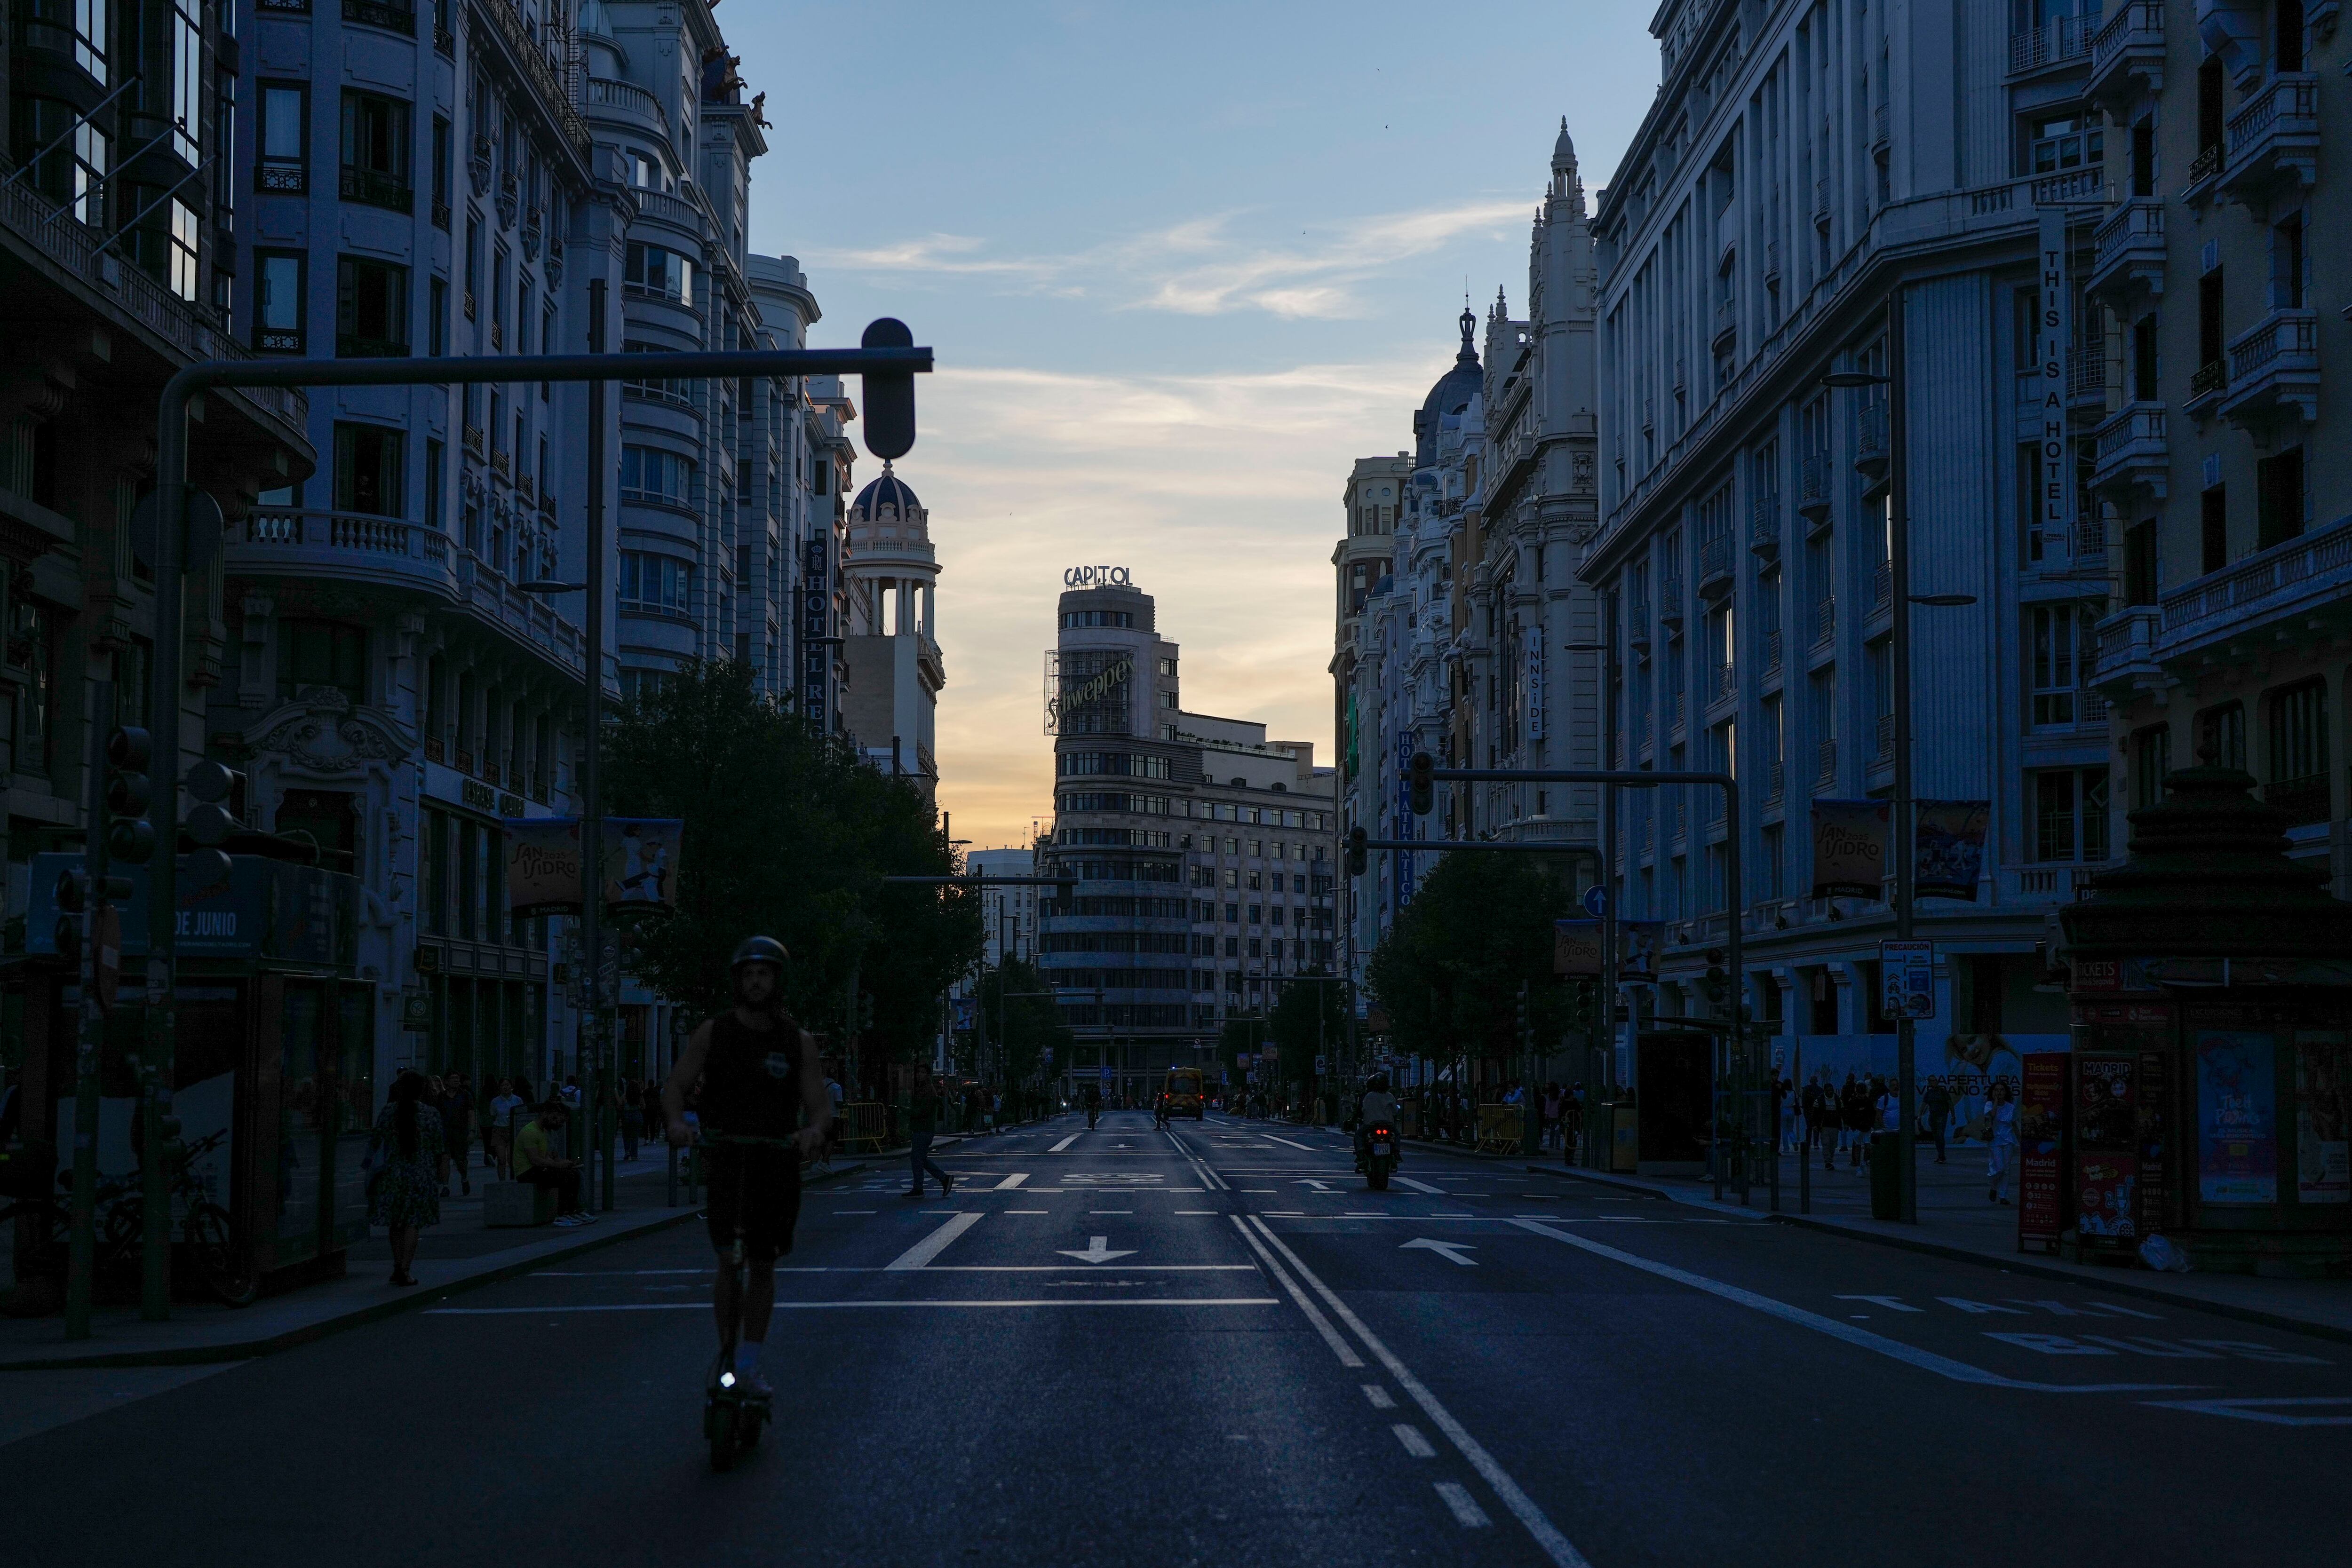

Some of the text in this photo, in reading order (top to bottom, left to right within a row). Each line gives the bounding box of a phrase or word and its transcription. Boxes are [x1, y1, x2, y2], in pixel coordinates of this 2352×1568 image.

[2045, 251, 2059, 327] THIS
[2046, 340, 2059, 379] IS
[2045, 392, 2061, 408] A
[2046, 421, 2061, 520] HOTEL
[1064, 565, 1133, 586] CAPITOL
[807, 576, 826, 673] HOTEL
[1048, 654, 1136, 728] Schweppes
[462, 778, 495, 810] ESPASA
[1400, 734, 1411, 906] HOTL ATLNTICO
[1817, 823, 1846, 844] SAN
[511, 842, 543, 864] SAN
[1834, 886, 1864, 895] MADRID
[540, 905, 569, 914] MADRID
[194, 911, 236, 936] JUNIO
[1557, 934, 1577, 948] SAN
[2026, 1062, 2059, 1072] Tickets
[2083, 1061, 2132, 1076] MADRID
[1938, 1074, 2021, 1085] APERTURA
[1915, 1085, 1980, 1096] VANO
[1983, 1085, 2020, 1096] 25
[2026, 1157, 2056, 1167] Madrid
[1831, 1293, 2167, 1320] TAXI
[1980, 1331, 2337, 1365] BUS
